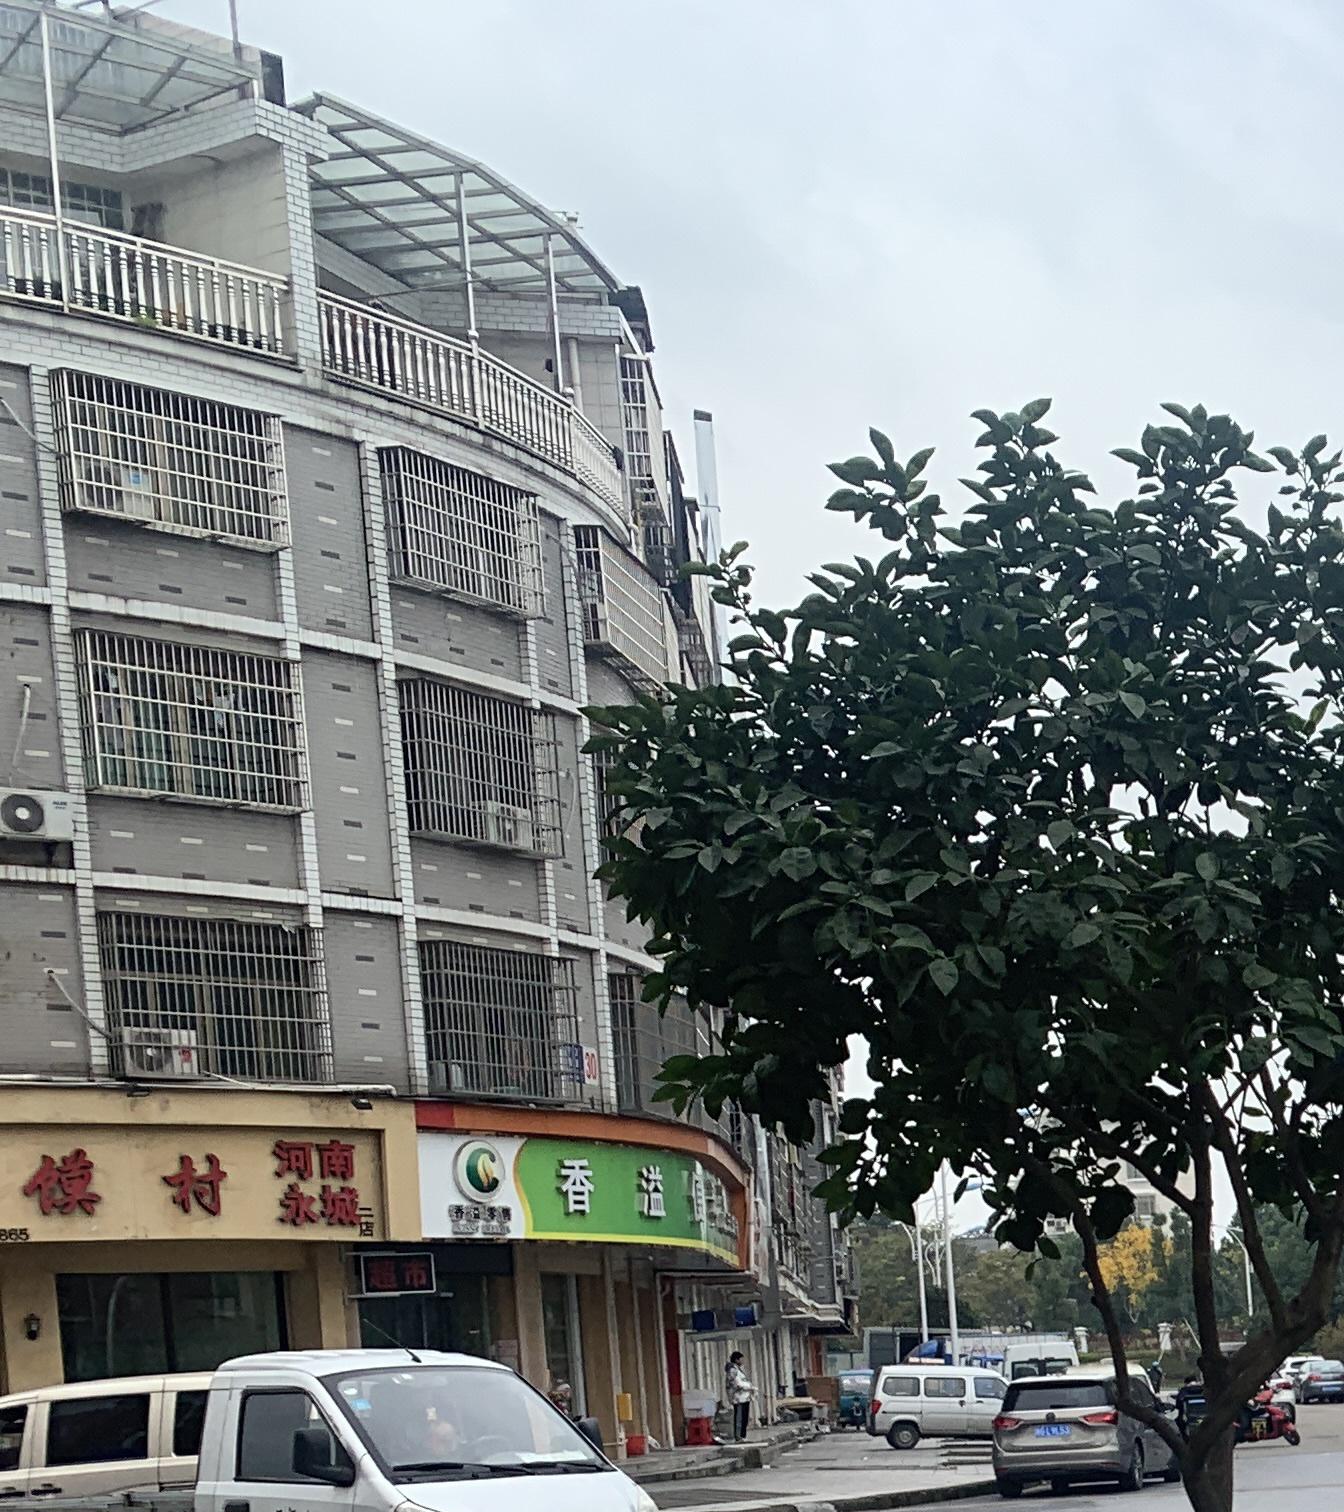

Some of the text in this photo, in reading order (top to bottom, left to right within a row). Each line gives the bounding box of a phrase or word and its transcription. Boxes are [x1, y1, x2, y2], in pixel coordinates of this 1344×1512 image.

[584, 1051, 597, 1080] 30
[272, 1140, 356, 1180] 河南
[279, 1183, 361, 1226] 永城
[359, 1207, 375, 1237] 二店
